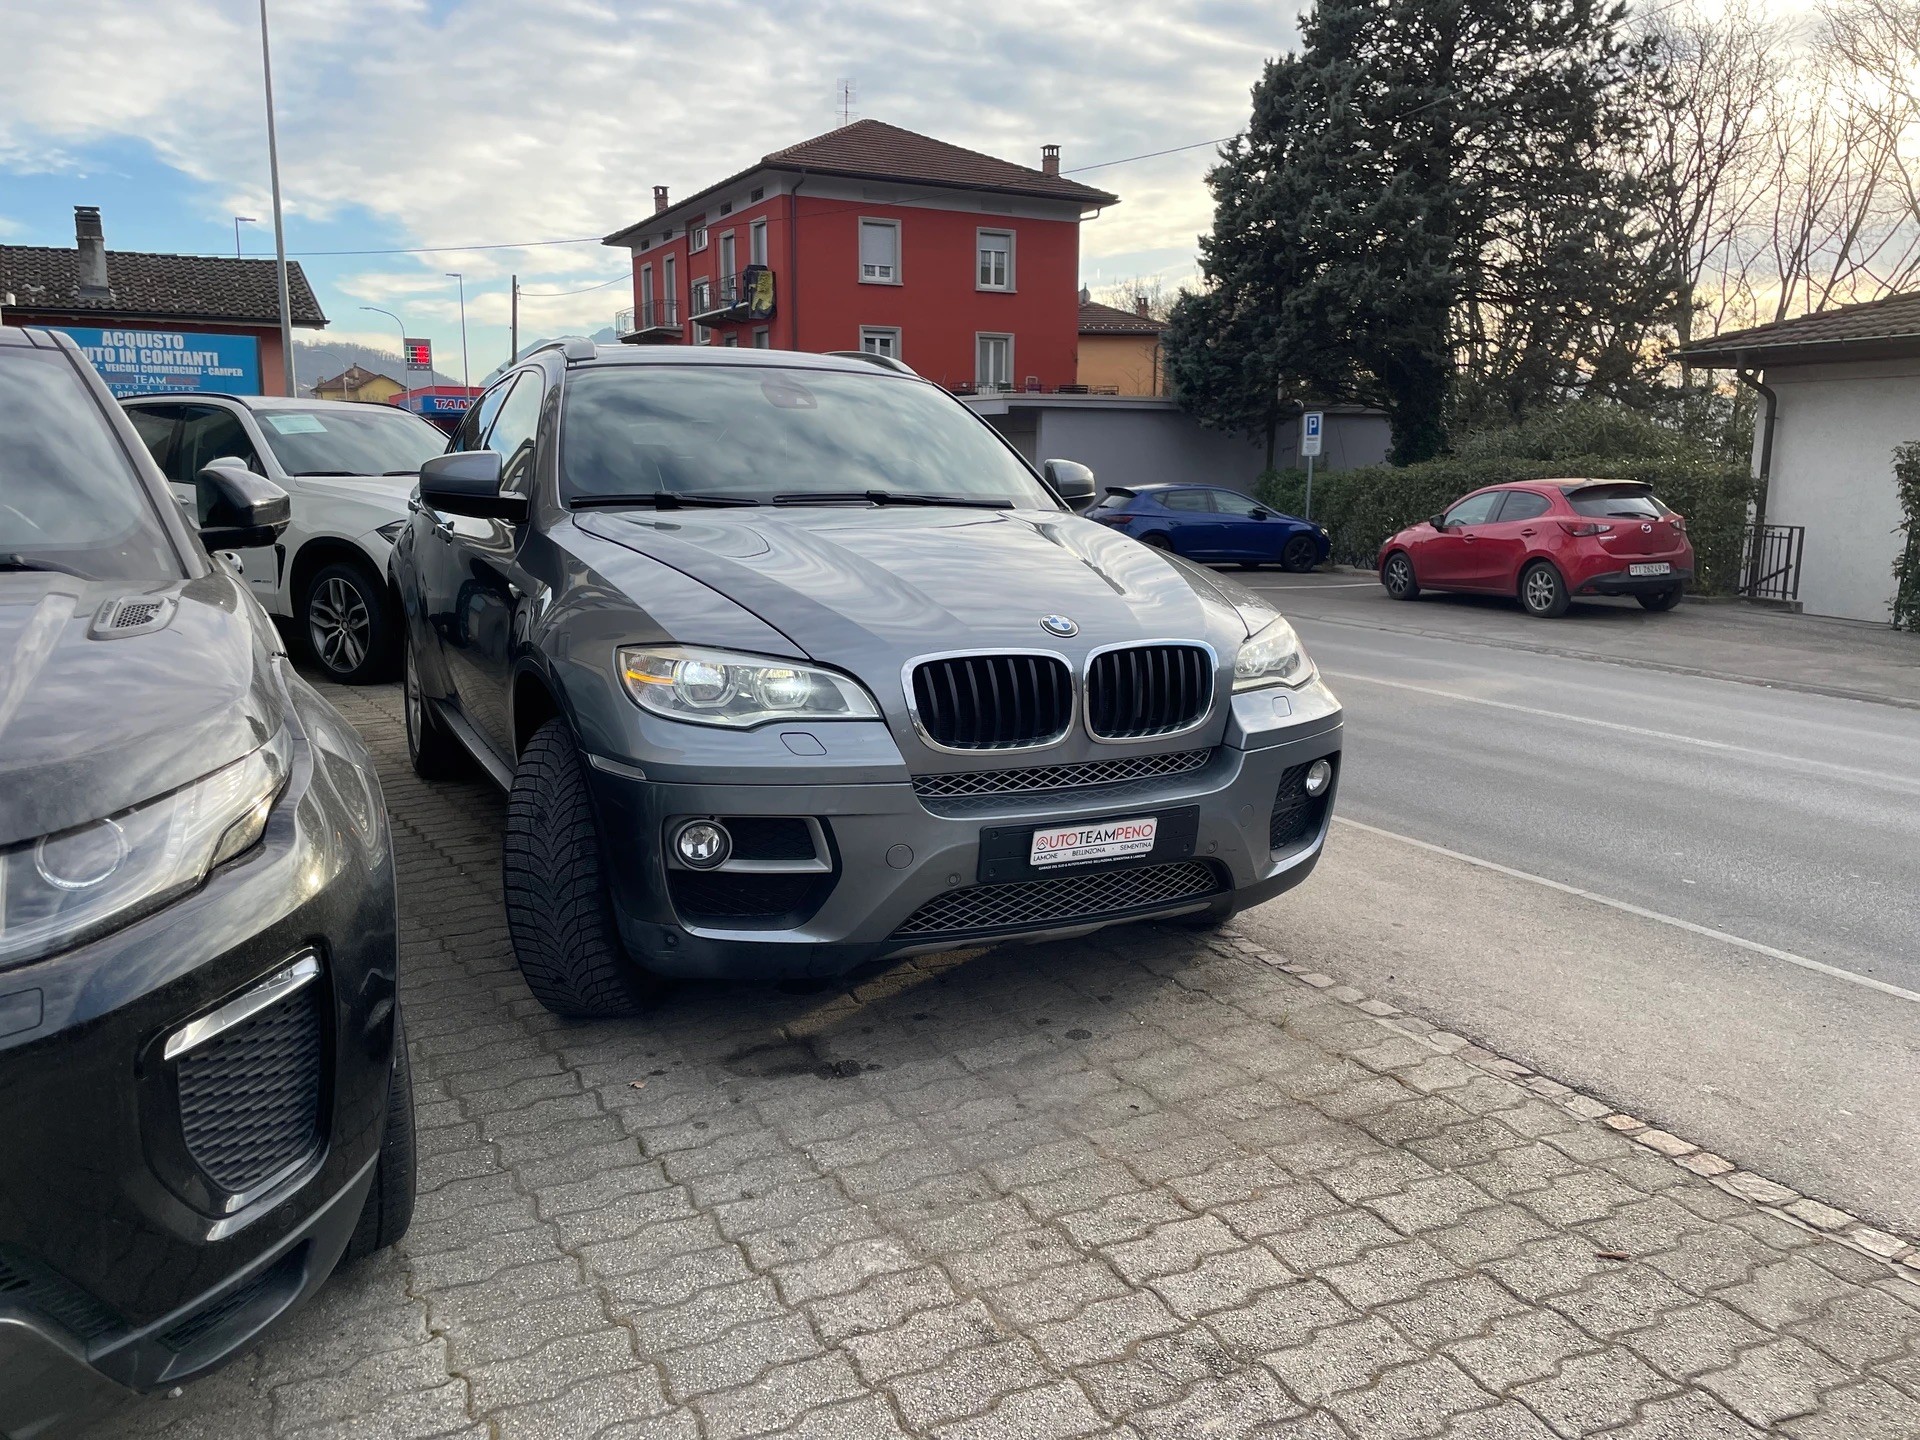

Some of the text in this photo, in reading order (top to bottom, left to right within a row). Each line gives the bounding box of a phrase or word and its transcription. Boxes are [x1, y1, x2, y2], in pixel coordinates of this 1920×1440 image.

[101, 331, 185, 350] ACQUISTO
[80, 347, 219, 367] UTO IN CONTANTI
[104, 363, 140, 373] VEICOLI
[140, 364, 201, 375] COMMERCIALI
[208, 367, 244, 377] CAMPER
[434, 398, 475, 410] TAM
[1308, 417, 1318, 435] P
[1033, 842, 1152, 862] LAMONE BELLINZONA SEMENTINA
